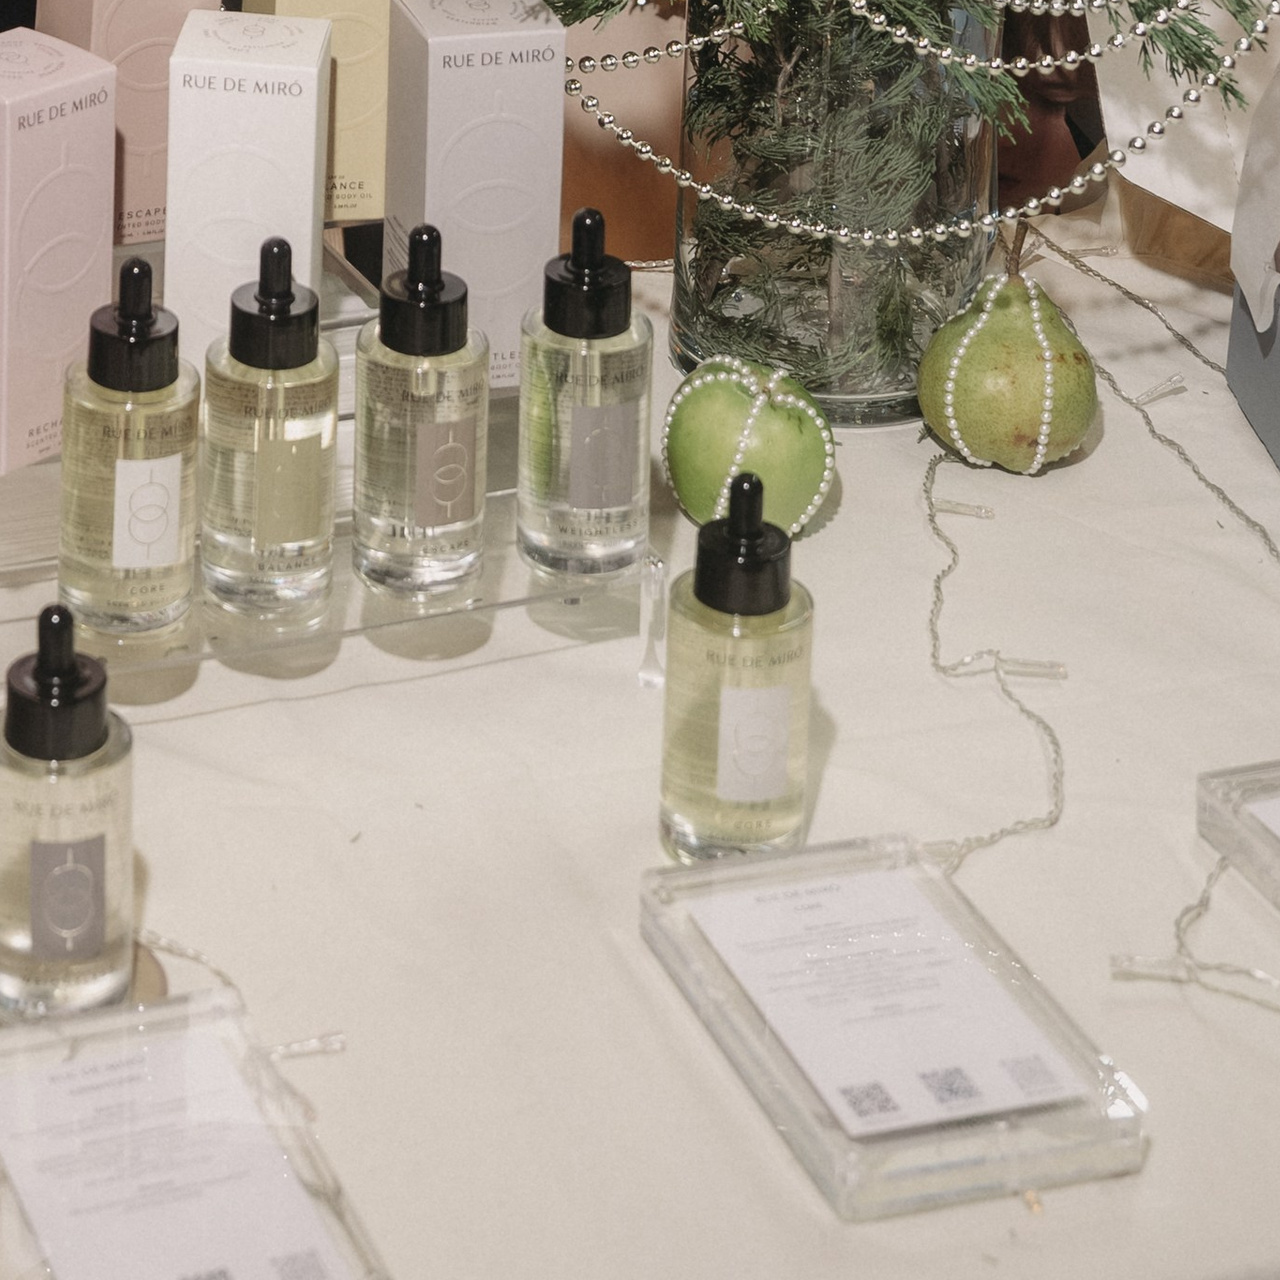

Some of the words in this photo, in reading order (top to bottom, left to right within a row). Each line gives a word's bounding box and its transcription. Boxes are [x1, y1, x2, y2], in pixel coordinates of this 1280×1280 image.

[443, 52, 475, 69] RUE
[481, 51, 503, 66] DE
[509, 44, 555, 65] MIRÓ
[183, 73, 217, 90] RUE
[223, 77, 246, 92] DE
[253, 79, 303, 97] MIRÓ
[17, 109, 44, 131] RUE
[49, 101, 66, 121] DE
[71, 86, 108, 113] MIRÓ
[136, 425, 158, 440] DE
[558, 519, 638, 537] WEIGHTLESS
[423, 540, 470, 554] ESCAPE
[257, 556, 317, 572] BALANCE
[130, 583, 166, 595] CORE
[706, 649, 736, 667] RUE
[742, 653, 764, 669] DE
